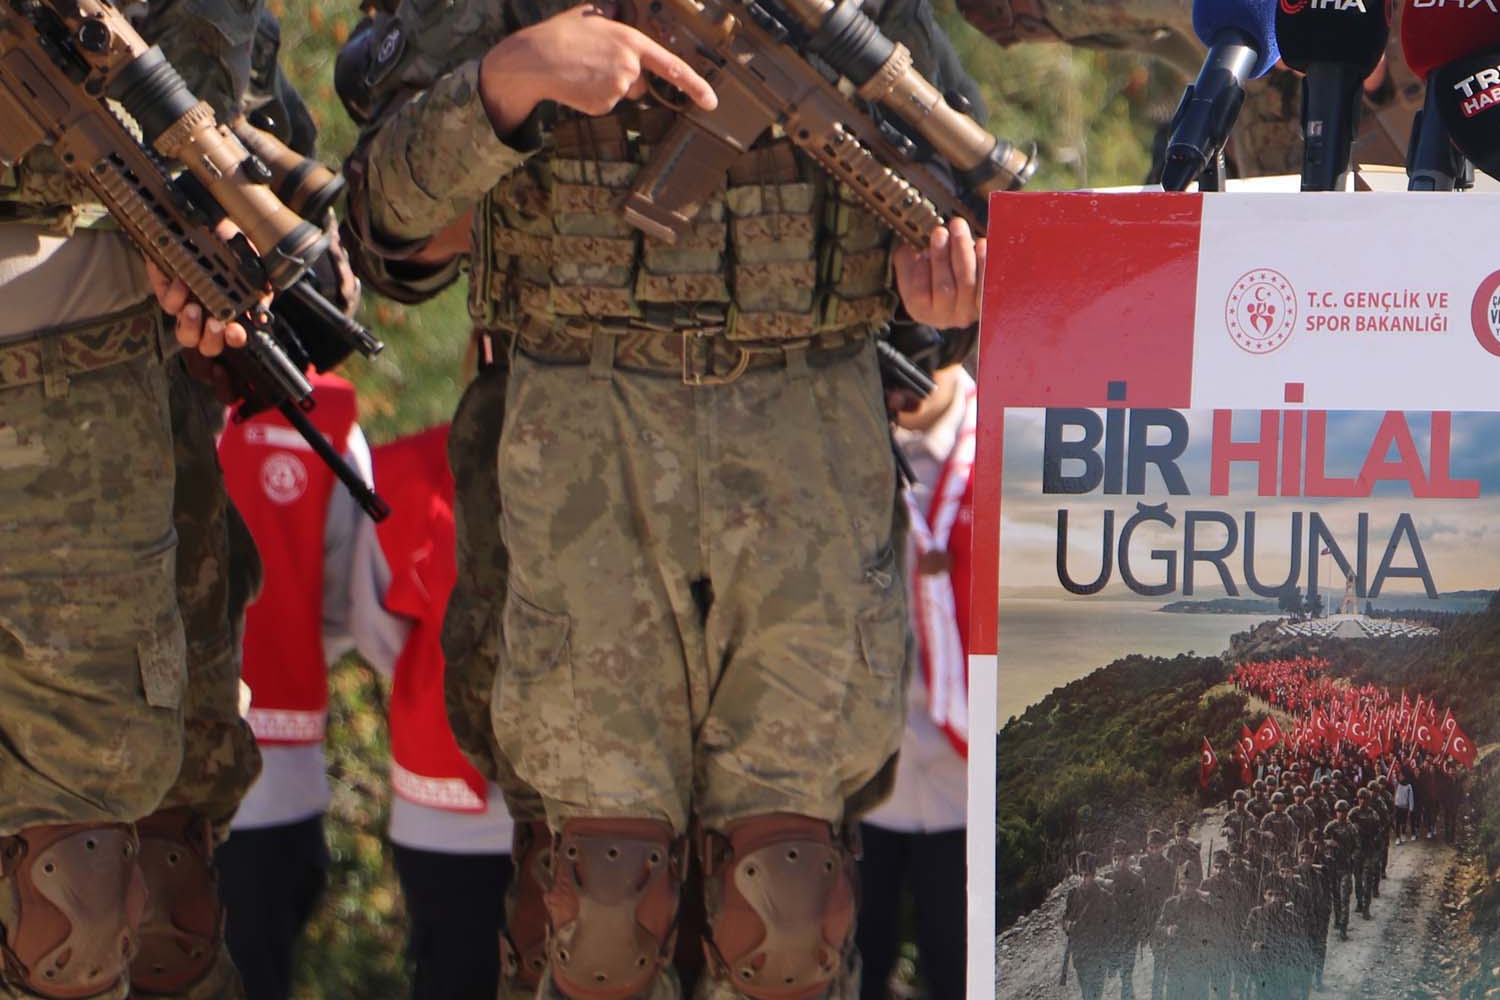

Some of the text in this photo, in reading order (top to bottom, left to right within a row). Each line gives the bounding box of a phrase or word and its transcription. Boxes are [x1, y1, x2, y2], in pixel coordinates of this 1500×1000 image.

[1306, 313, 1448, 332] SPOR BAKANLIĞI
[1307, 288, 1449, 313] T.C. GENÇLİK VE
[1042, 380, 1481, 498] BİR HİLAL
[1056, 501, 1439, 599] UĞRUNA
